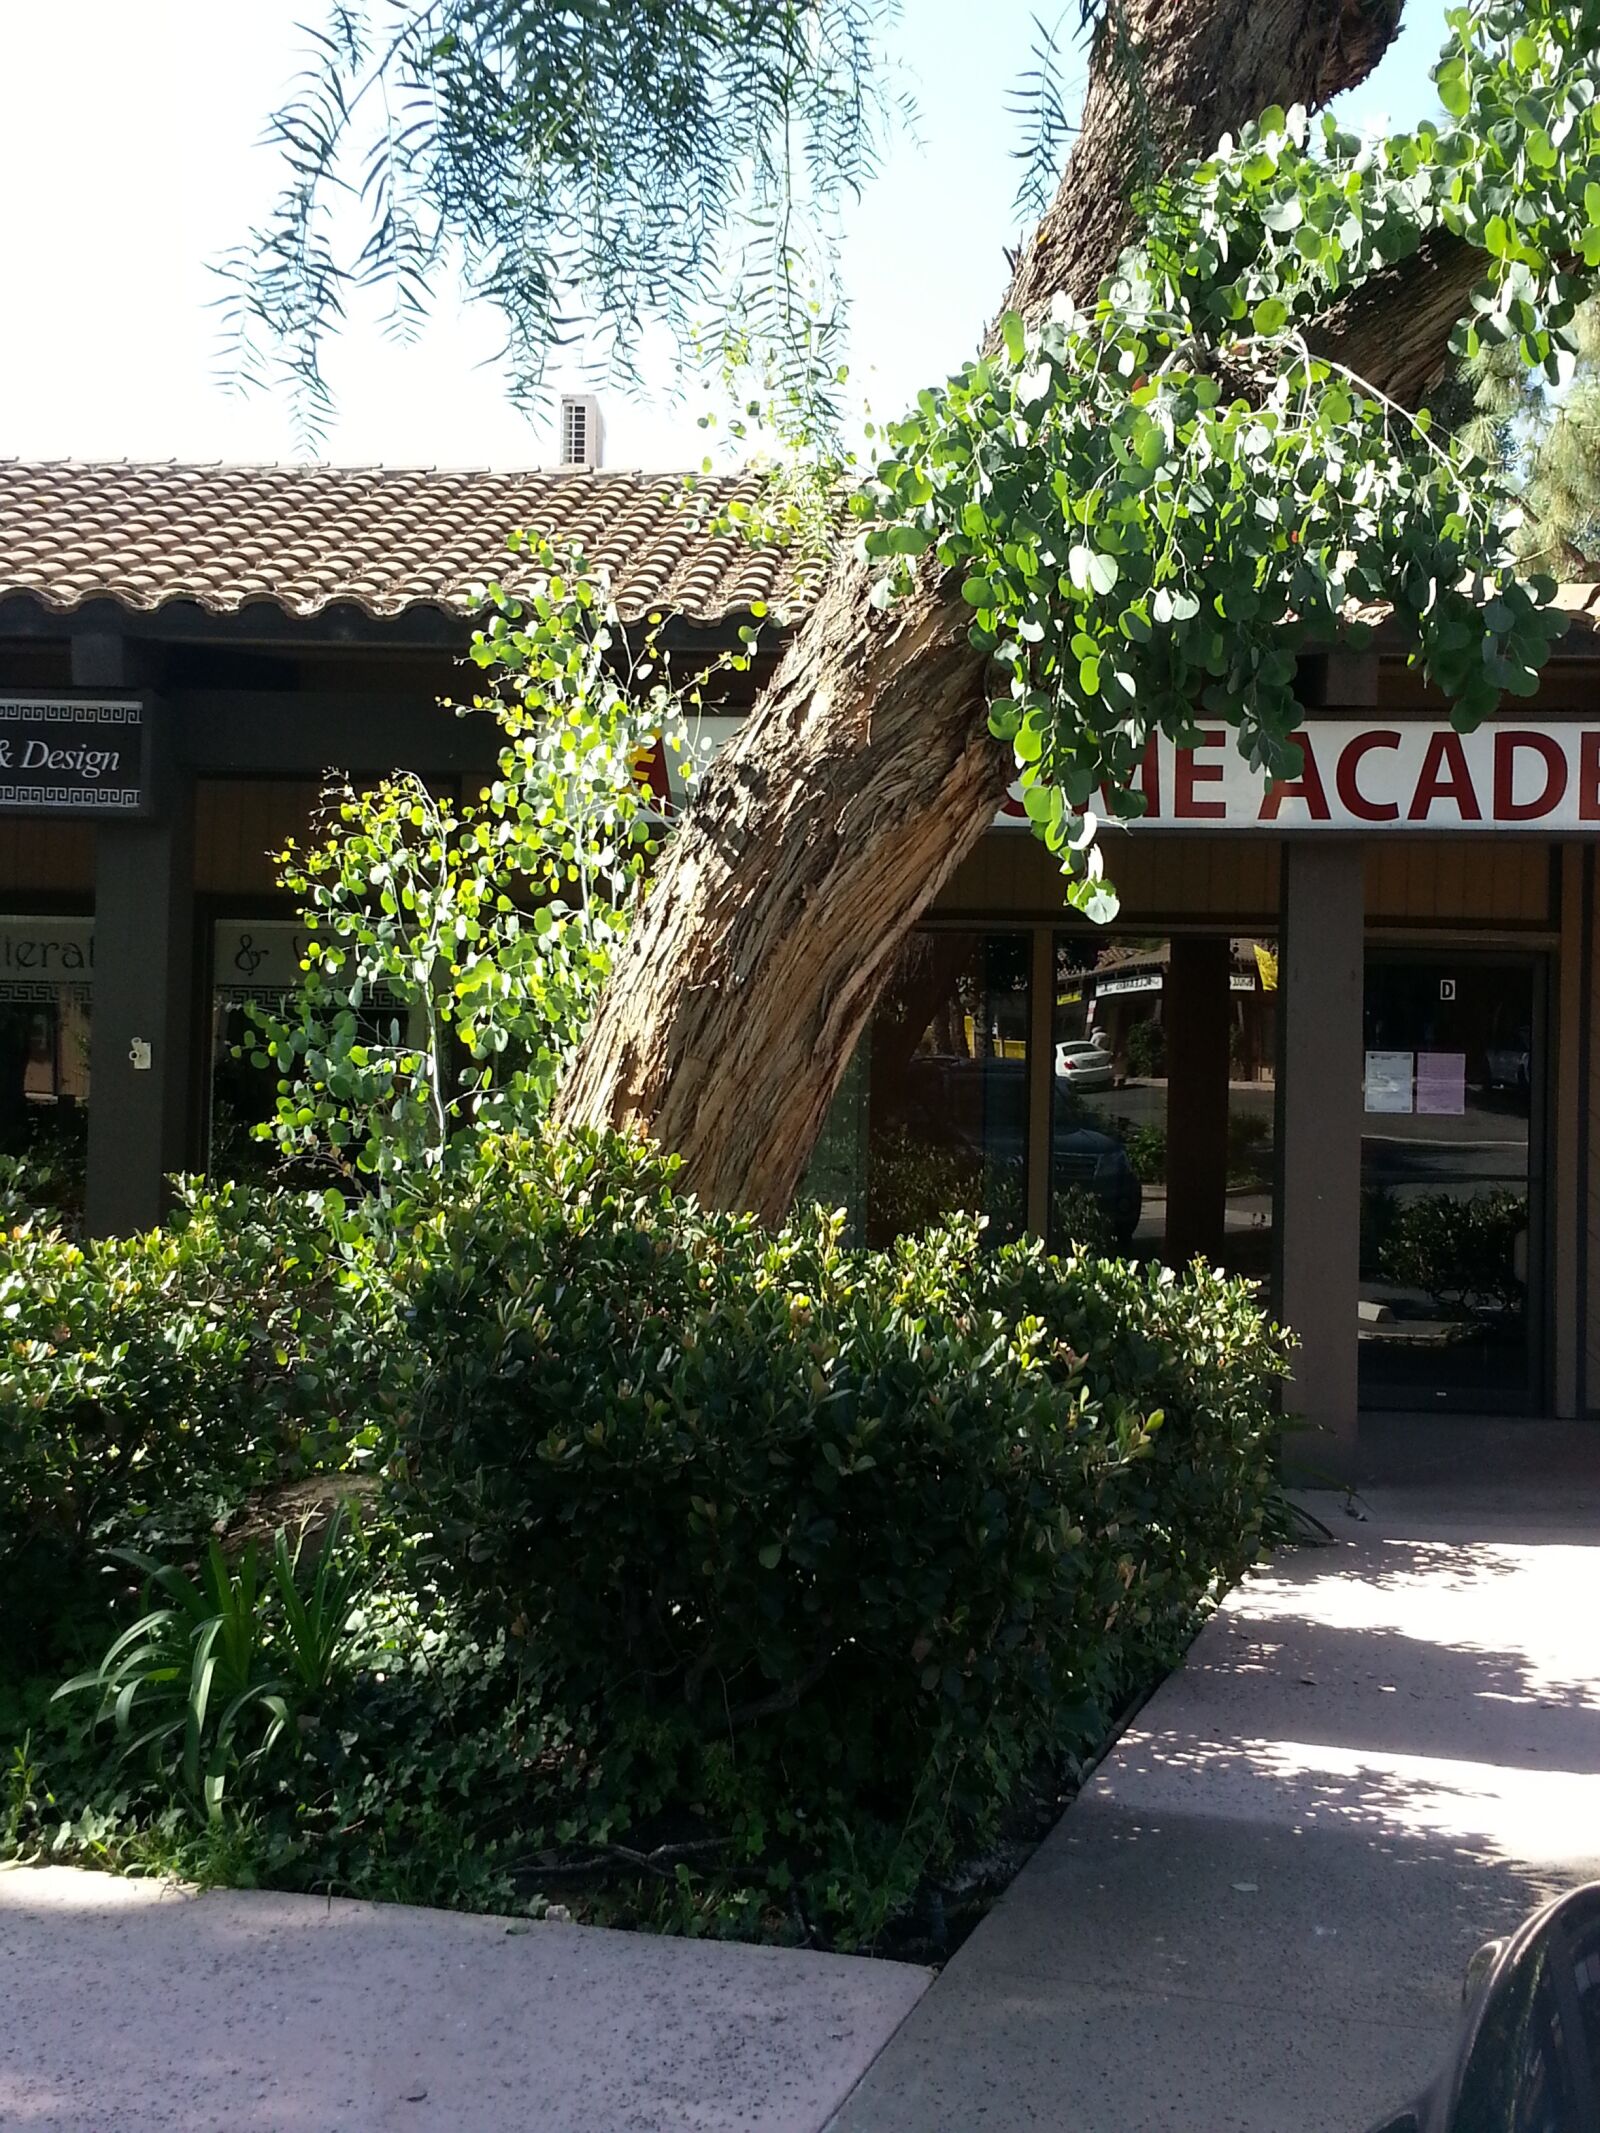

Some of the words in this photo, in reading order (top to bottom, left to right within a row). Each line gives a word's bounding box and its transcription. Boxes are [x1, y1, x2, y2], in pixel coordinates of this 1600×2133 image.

[19, 740, 120, 779] Design
[235, 934, 270, 976] &
[1442, 981, 1454, 998] D
